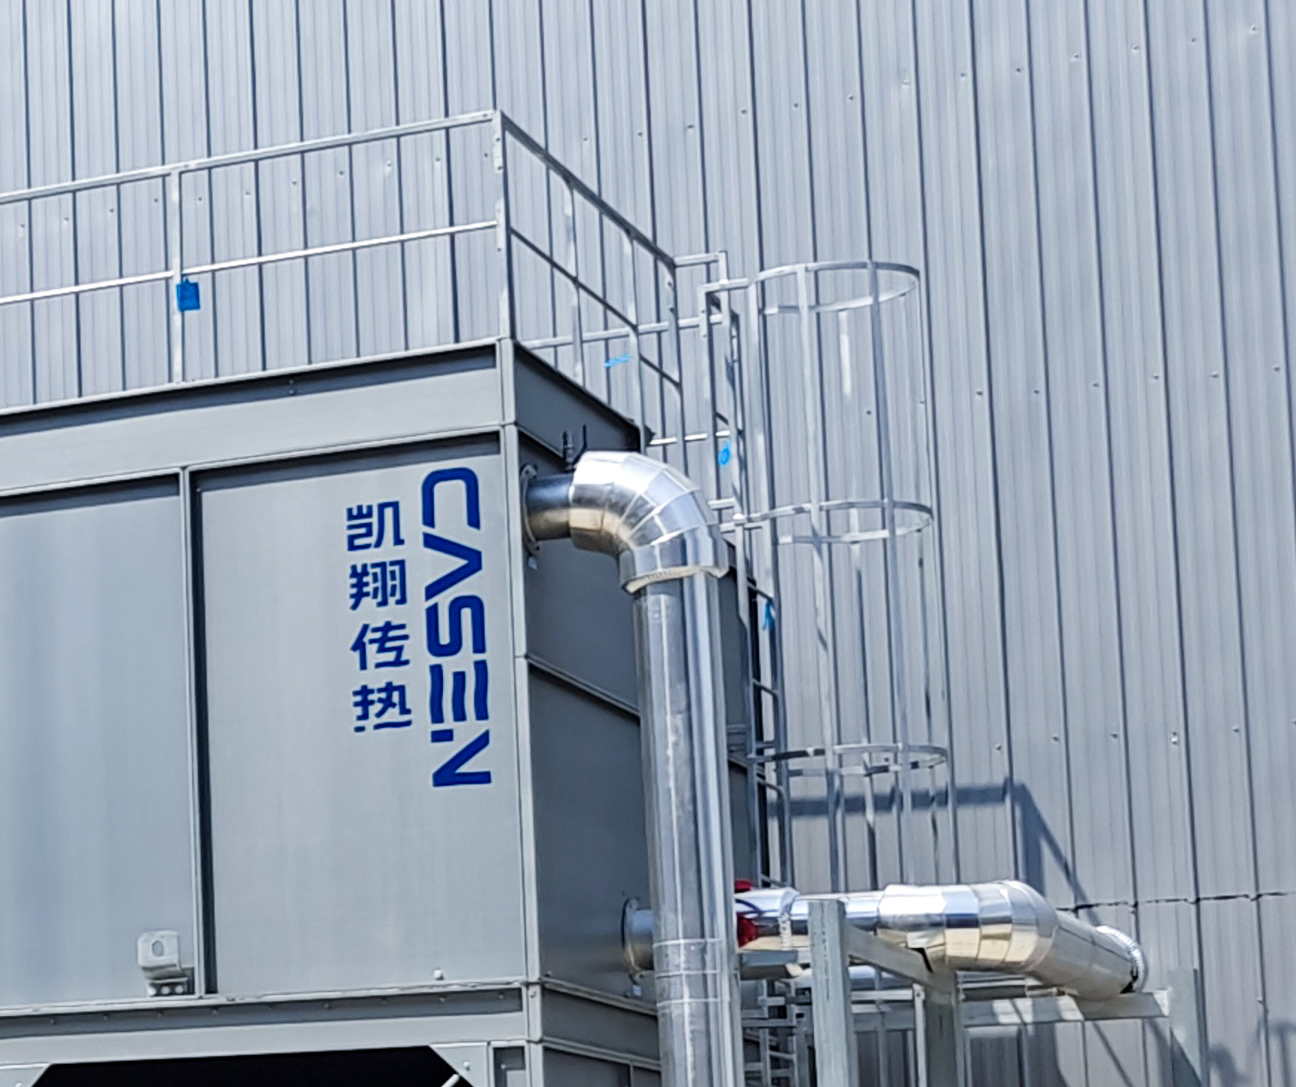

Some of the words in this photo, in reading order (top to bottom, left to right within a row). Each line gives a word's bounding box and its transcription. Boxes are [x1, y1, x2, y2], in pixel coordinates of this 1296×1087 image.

[346, 500, 412, 733] 凯翔传热
[421, 467, 492, 788] CASEN
